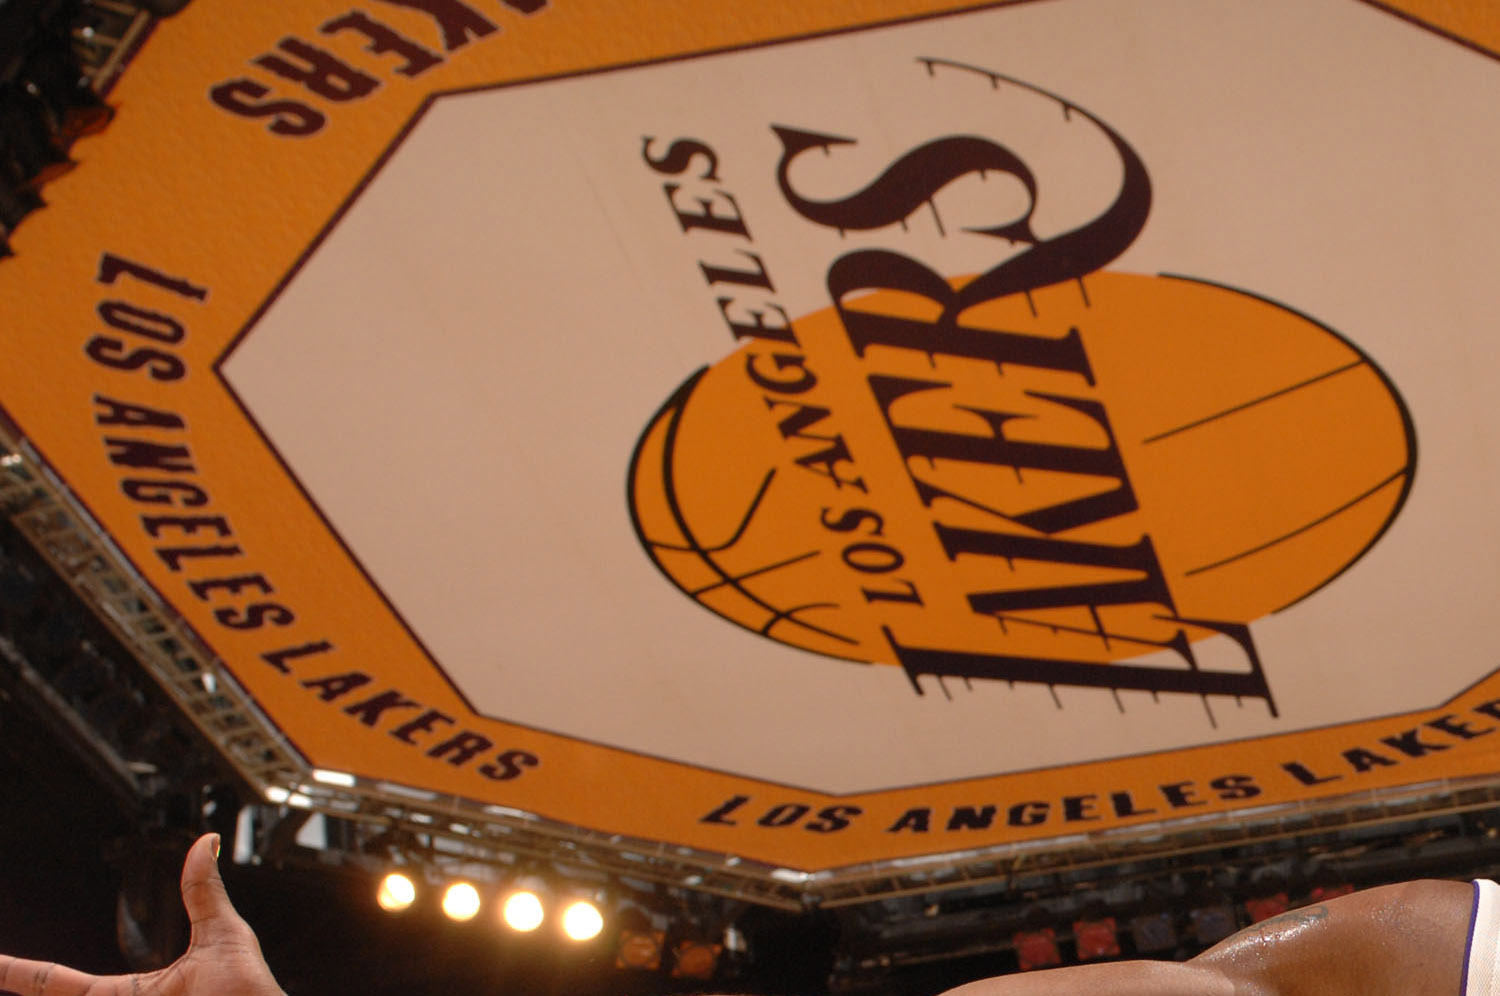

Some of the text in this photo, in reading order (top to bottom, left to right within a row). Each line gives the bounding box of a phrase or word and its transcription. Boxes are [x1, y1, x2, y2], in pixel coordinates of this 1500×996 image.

[84, 252, 540, 781] LOS ANGELES LAKERS
[641, 135, 925, 608] LOS ANGELES
[769, 56, 1279, 729] LAKERS
[699, 795, 862, 834] LOS
[886, 774, 1262, 837] ANGELES
